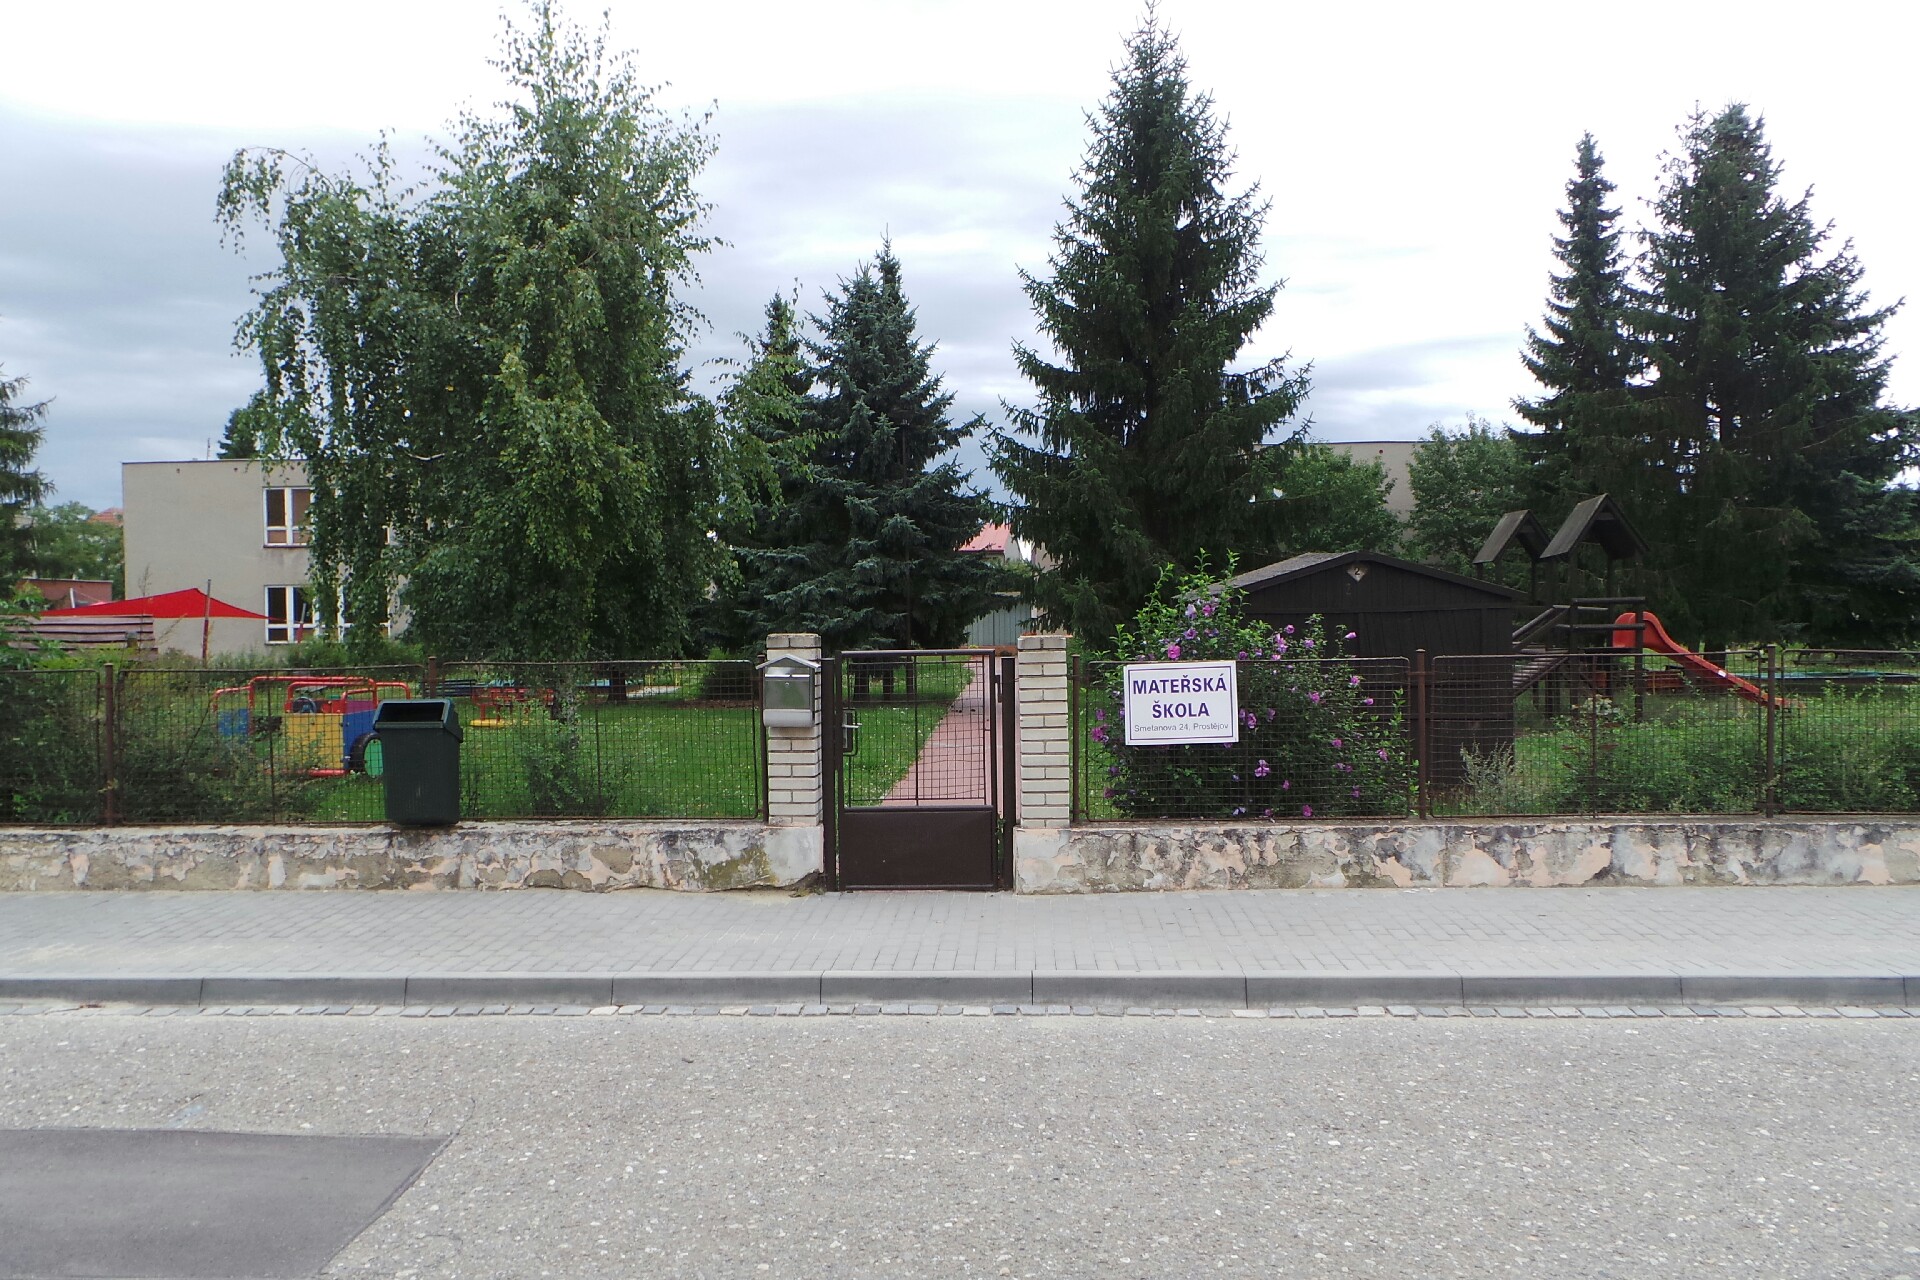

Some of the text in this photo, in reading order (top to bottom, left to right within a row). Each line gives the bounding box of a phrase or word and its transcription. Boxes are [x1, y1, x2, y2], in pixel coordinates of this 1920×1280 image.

[1133, 674, 1227, 694] MATEŘSKÁ
[1152, 700, 1209, 718] ŠKOLA
[1134, 724, 1177, 732] Smetanova
[1193, 722, 1228, 731] Prostějov
